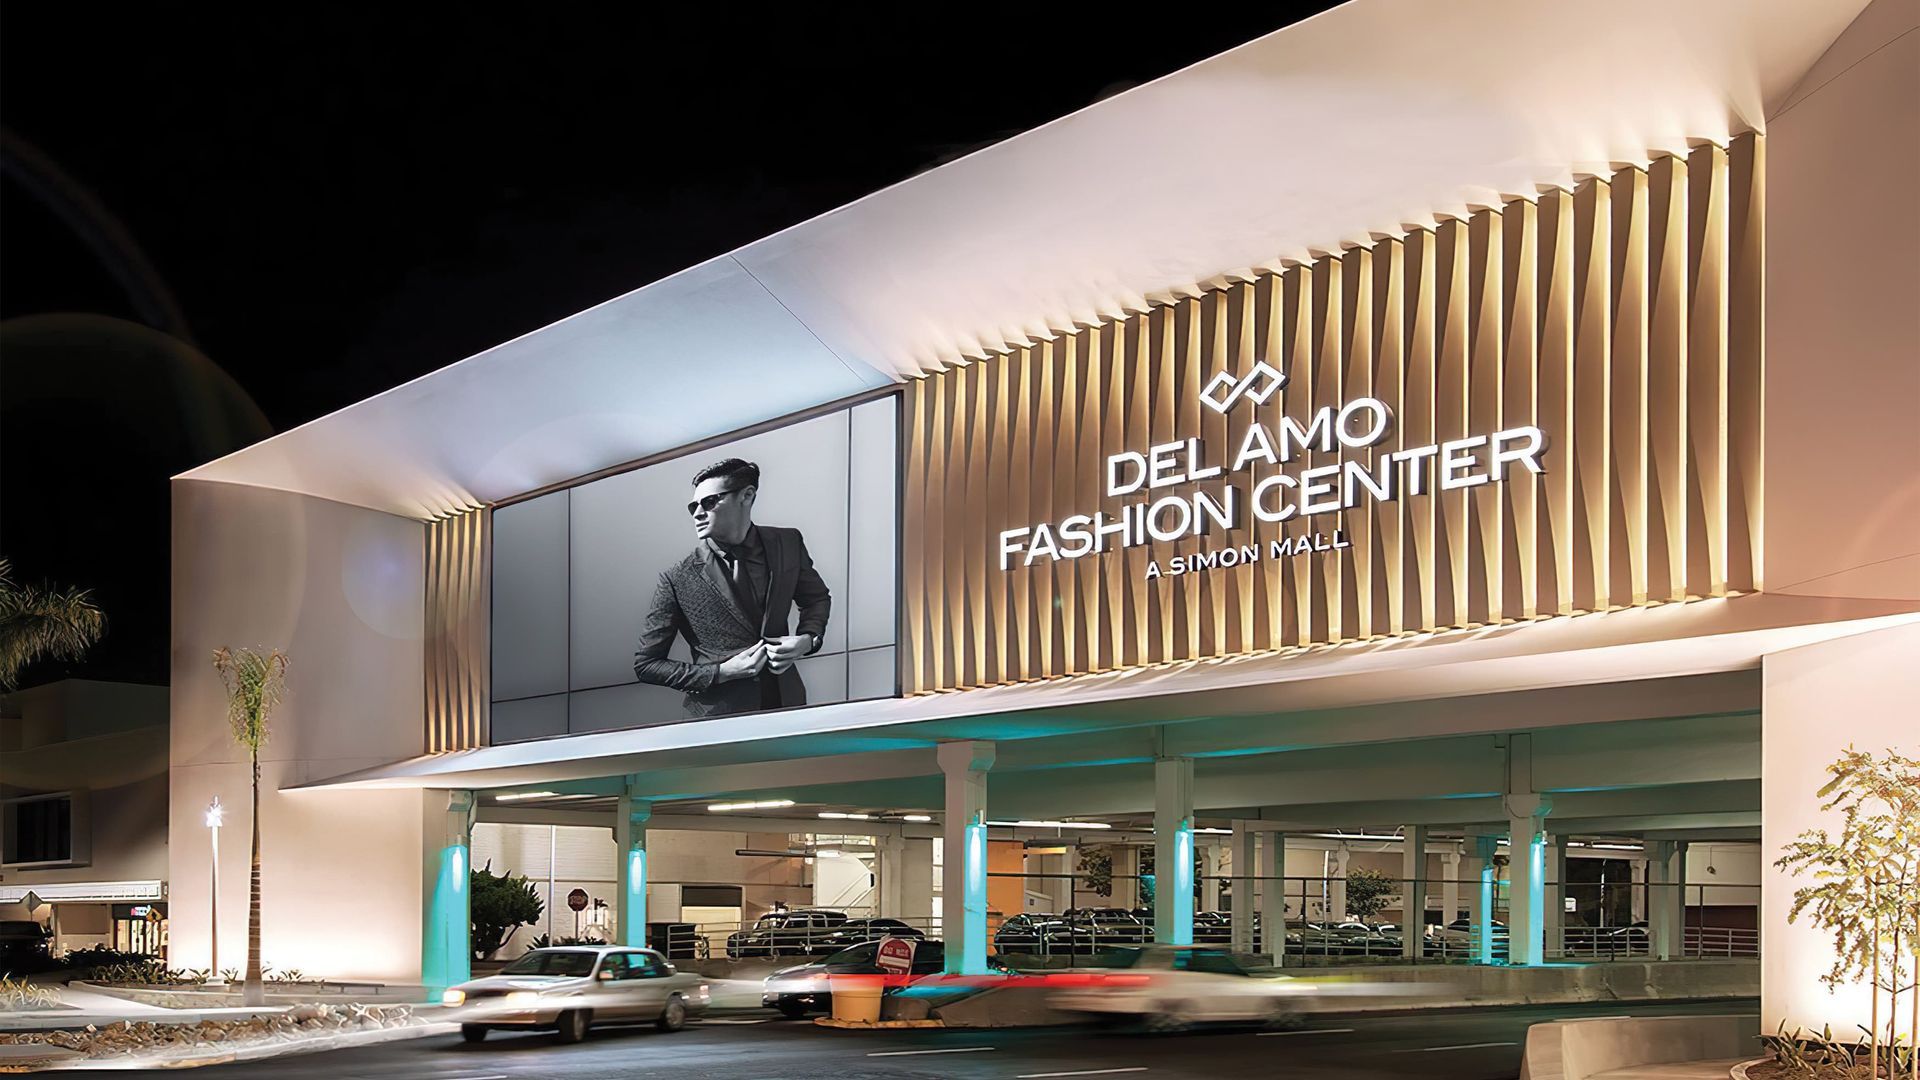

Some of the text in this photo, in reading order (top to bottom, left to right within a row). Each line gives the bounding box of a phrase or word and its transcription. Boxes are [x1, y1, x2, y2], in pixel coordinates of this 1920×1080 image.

[999, 426, 1544, 570] FASHION CENTER
[1107, 397, 1388, 498] DEL AMO
[1145, 530, 1350, 580] A SIMON MALL
